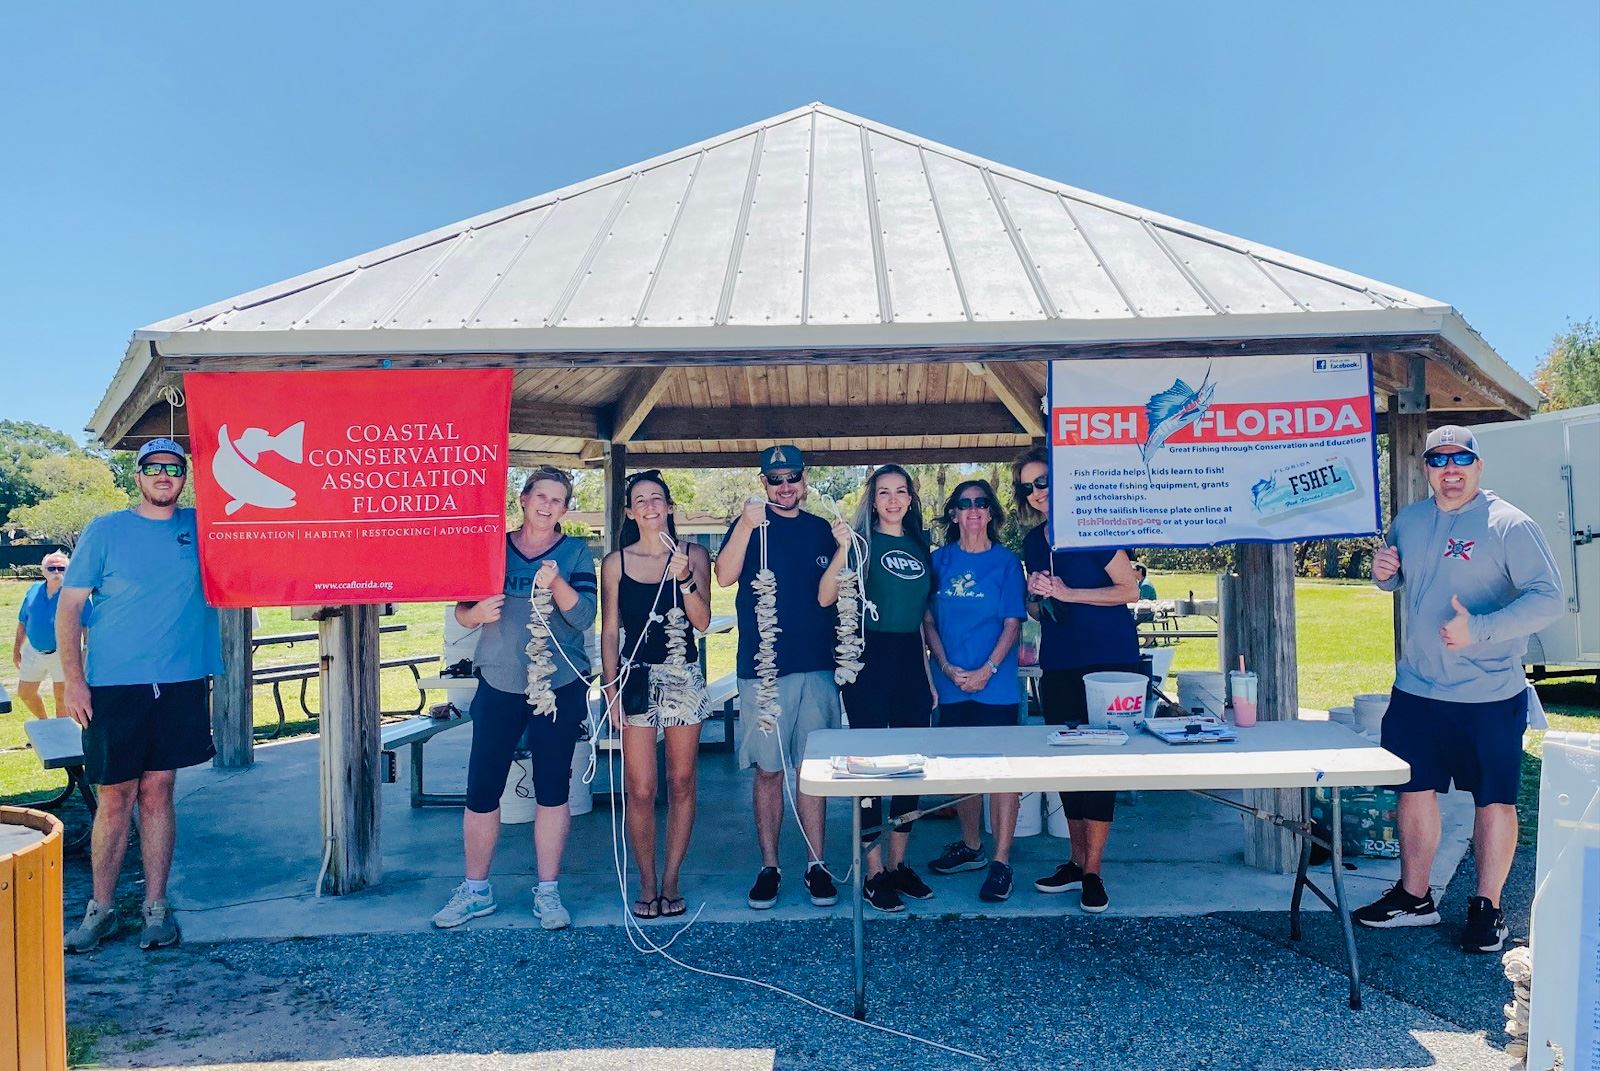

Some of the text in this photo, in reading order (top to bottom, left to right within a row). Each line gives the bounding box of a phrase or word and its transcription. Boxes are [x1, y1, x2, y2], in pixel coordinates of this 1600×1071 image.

[1058, 404, 1363, 440] FISH FLORIDA
[346, 422, 459, 443] COASTAL
[1169, 437, 1367, 455] Great Fishing through Conservation and Education
[308, 444, 499, 468] CONSERVATION
[321, 468, 487, 490] ASSOCIATION
[1074, 466, 1225, 477] Fish Florida helps kids learn to fish!
[1074, 481, 1229, 492] We donate fishing equipment, grants
[1288, 464, 1342, 496] FSHFL
[352, 494, 458, 514] FLORIDA
[1075, 493, 1147, 502] and scholarships.
[1076, 505, 1233, 516] Buy the sailfish license plate online at
[1077, 518, 1161, 527] FishFloridaTag.org
[1184, 518, 1204, 527] your
[1205, 517, 1227, 525] local
[208, 524, 499, 541] CONSERVATION HABITAT RESTOCKING ADVOCACY
[1093, 528, 1136, 537] collector's
[1137, 527, 1164, 535] office.
[885, 556, 922, 571] NPB
[313, 580, 394, 591] www.ccaflorida.org
[505, 575, 532, 591] NP
[1107, 695, 1143, 711] ACE
[1364, 839, 1400, 852] ROSS
